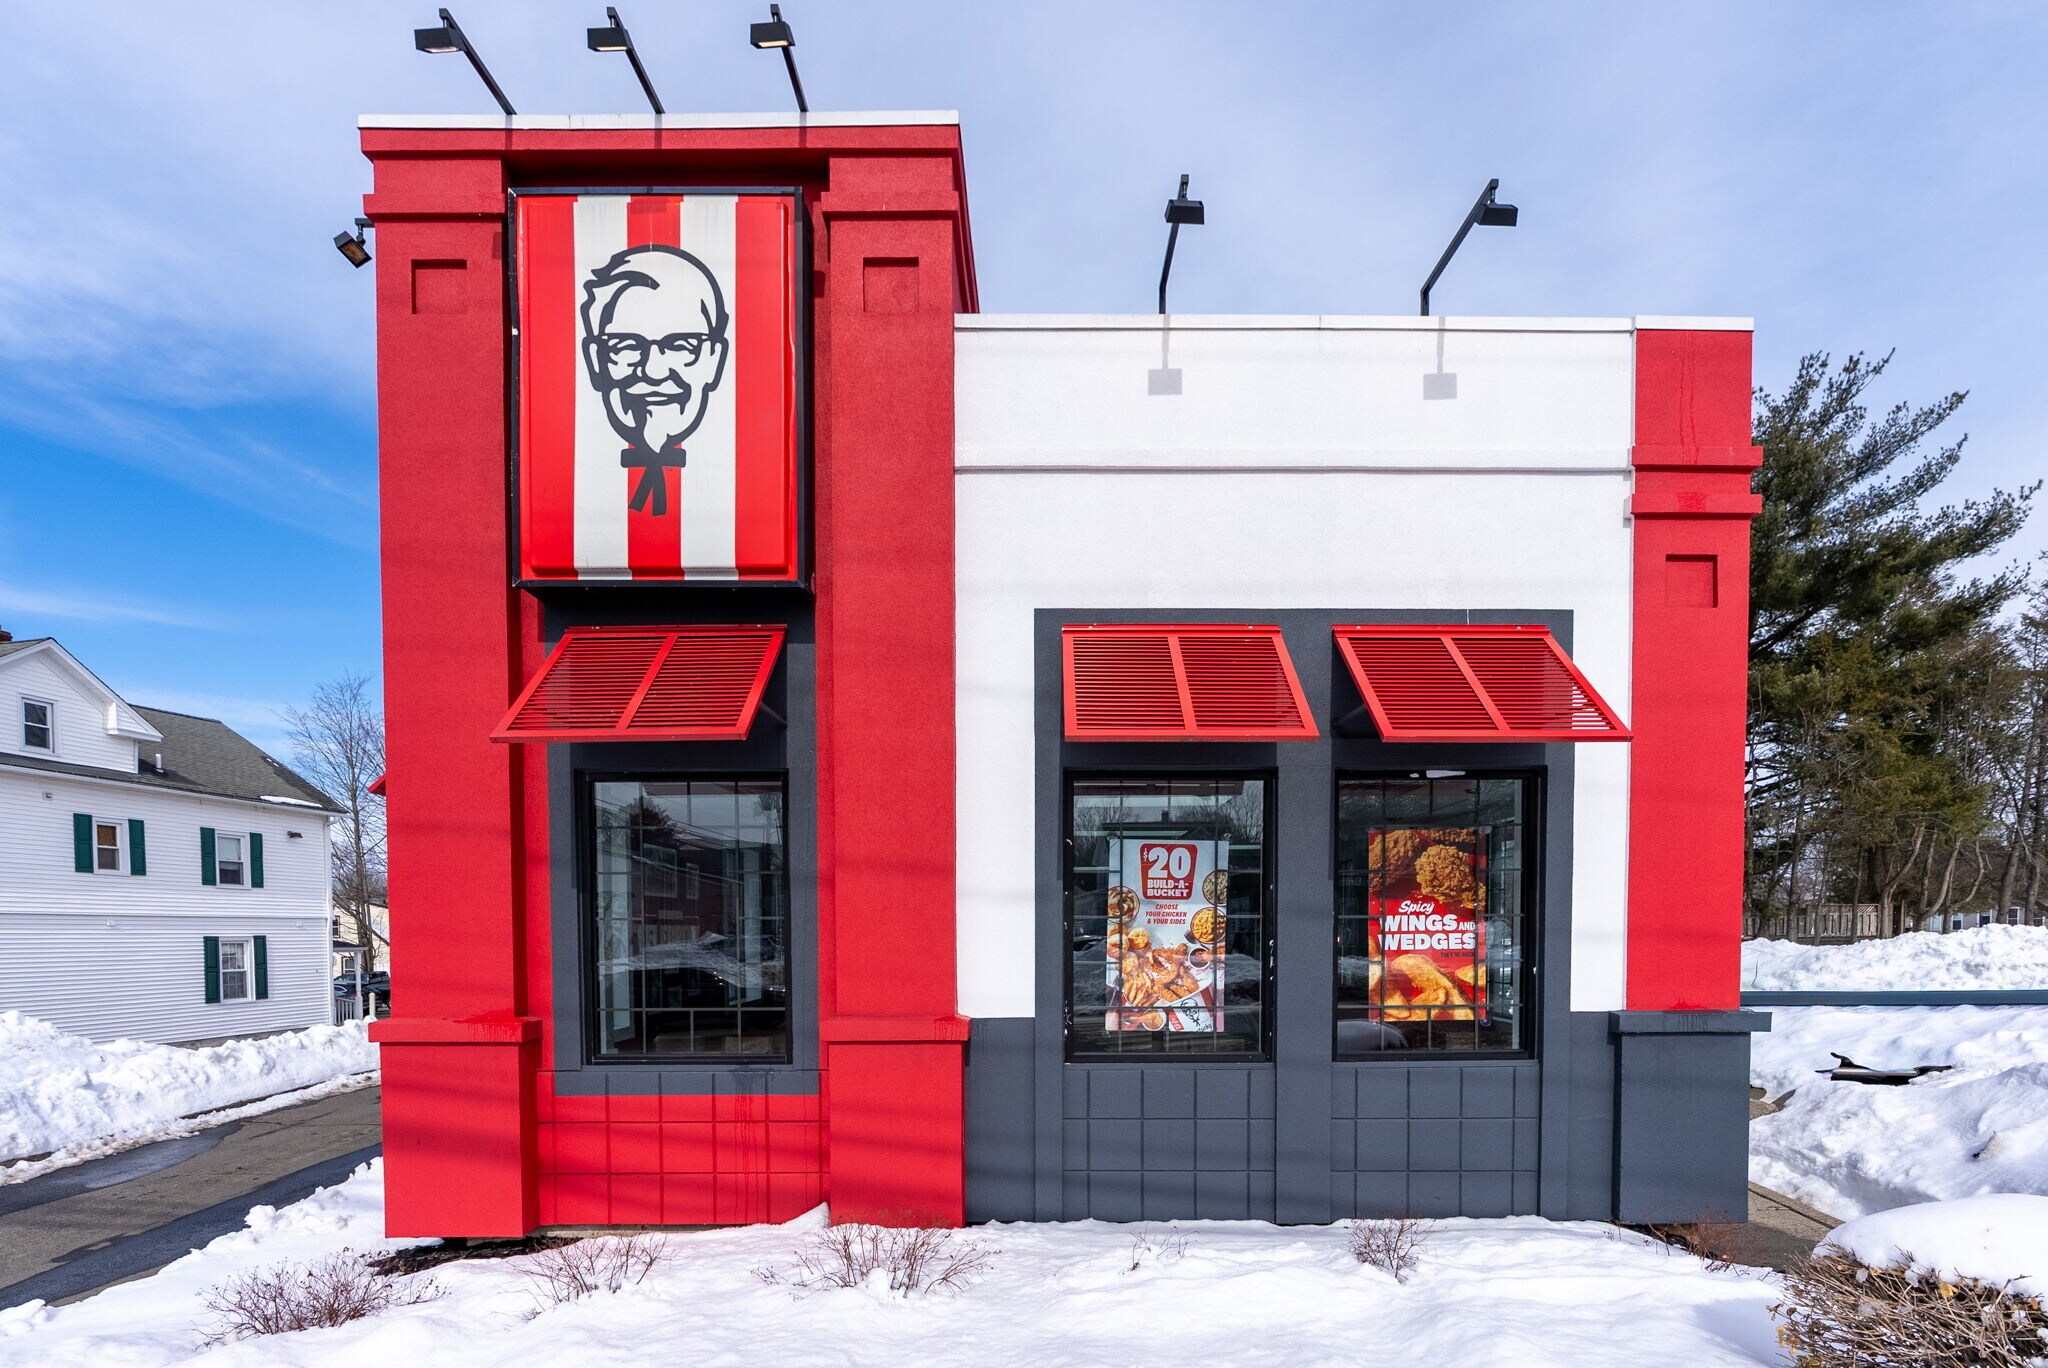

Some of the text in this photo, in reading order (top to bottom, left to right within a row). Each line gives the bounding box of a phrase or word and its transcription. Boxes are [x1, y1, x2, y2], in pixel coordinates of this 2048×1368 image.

[1143, 847, 1191, 878] $20
[1147, 879, 1189, 888] BUILD-A-
[1147, 888, 1189, 896] BUCKET
[1398, 900, 1435, 914] Spicy
[1380, 914, 1476, 932] WINGS AND
[1378, 933, 1476, 950] WEDGES
